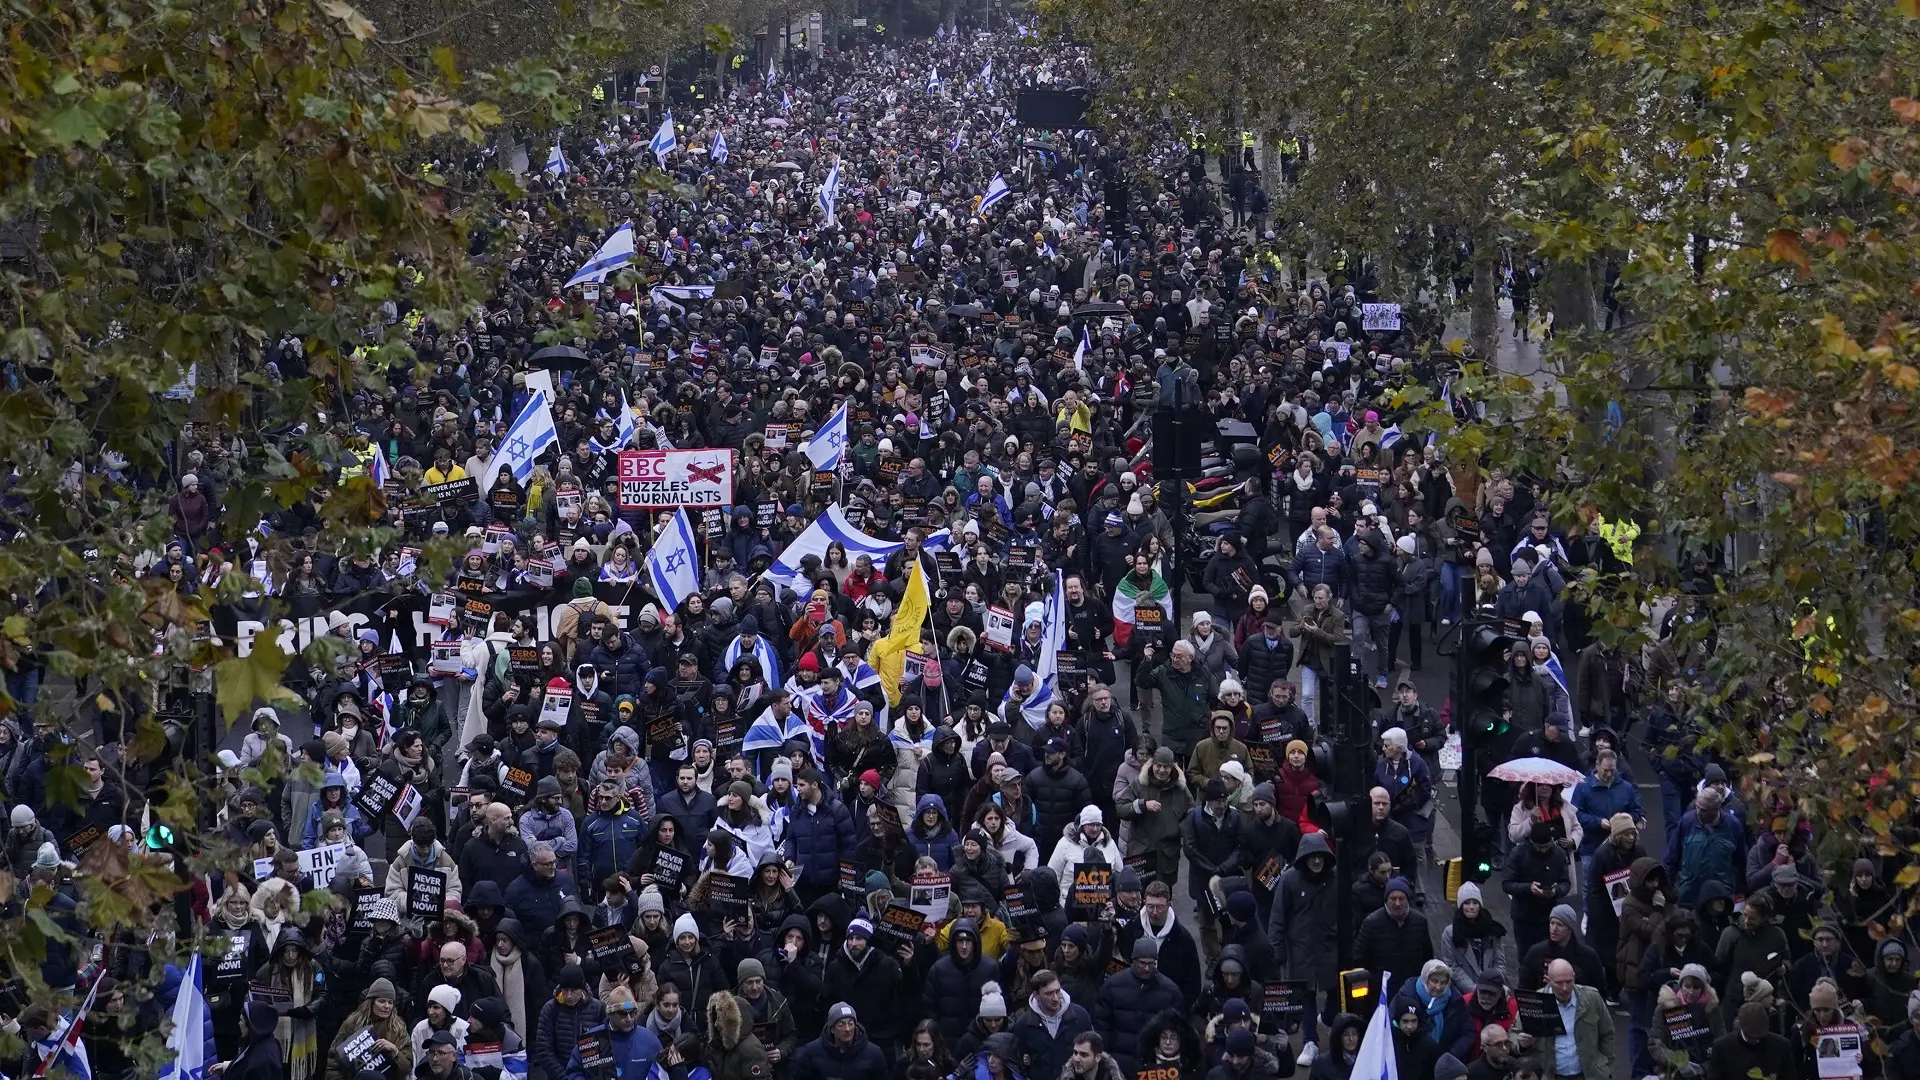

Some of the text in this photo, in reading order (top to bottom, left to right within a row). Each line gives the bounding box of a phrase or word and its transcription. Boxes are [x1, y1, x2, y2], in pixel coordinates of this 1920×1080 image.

[650, 66, 660, 74] 20
[1072, 434, 1092, 444] ACT
[1267, 444, 1281, 461] ACT
[620, 458, 666, 476] BBC
[428, 484, 448, 493] NEVER
[449, 480, 470, 489] AGAIN
[621, 481, 689, 492] MUZZLES
[622, 490, 721, 504] JOURNALISTS
[459, 581, 482, 590] ACT
[466, 598, 491, 611] ZERO
[990, 604, 1013, 616] KIDNAPPED
[1136, 610, 1160, 618] ZERO
[969, 672, 987, 682] NOW!
[651, 716, 674, 731] ACT
[1262, 722, 1282, 730] KINGDOM
[1263, 733, 1292, 742] ANTISEMITISM
[1250, 748, 1270, 758] ACT
[509, 767, 532, 782] ZERO
[370, 782, 393, 800] AGAIN
[375, 776, 397, 794] NEVER
[362, 795, 382, 812] NOW!
[372, 793, 381, 801] IS
[68, 826, 97, 847] ZERO
[659, 851, 683, 865] NEVER
[656, 858, 682, 872] AGAIN
[414, 873, 441, 886] NEVER
[653, 874, 676, 885] NOW!
[1075, 871, 1110, 884] ACT
[1605, 869, 1630, 882] KIDNAPP
[412, 882, 440, 895] AGAIN
[359, 894, 380, 903] NEVER
[421, 894, 430, 902] IS
[711, 896, 747, 904] ANTISEMITISM
[412, 901, 437, 912] NOW!
[884, 908, 922, 925] ZERO
[878, 926, 913, 940] ANTISEMITES
[596, 943, 631, 958] BRITISH JEWS
[217, 960, 241, 970] NOW!
[251, 986, 289, 995] KIDNAPPED
[1666, 1013, 1692, 1023] KINGDOM
[1670, 1026, 1693, 1035] AGAINST
[1672, 1027, 1709, 1040] ANTISEMITISM
[344, 1030, 370, 1054] NEVER
[579, 1041, 599, 1050] KINGDOM
[348, 1036, 375, 1062] AGAIN
[361, 1052, 372, 1063] IS
[363, 1054, 385, 1070] OW!
[582, 1054, 600, 1064] AGAINST
[583, 1057, 613, 1068] ANTISEMITISM
[1137, 1067, 1179, 1080] ZERO
